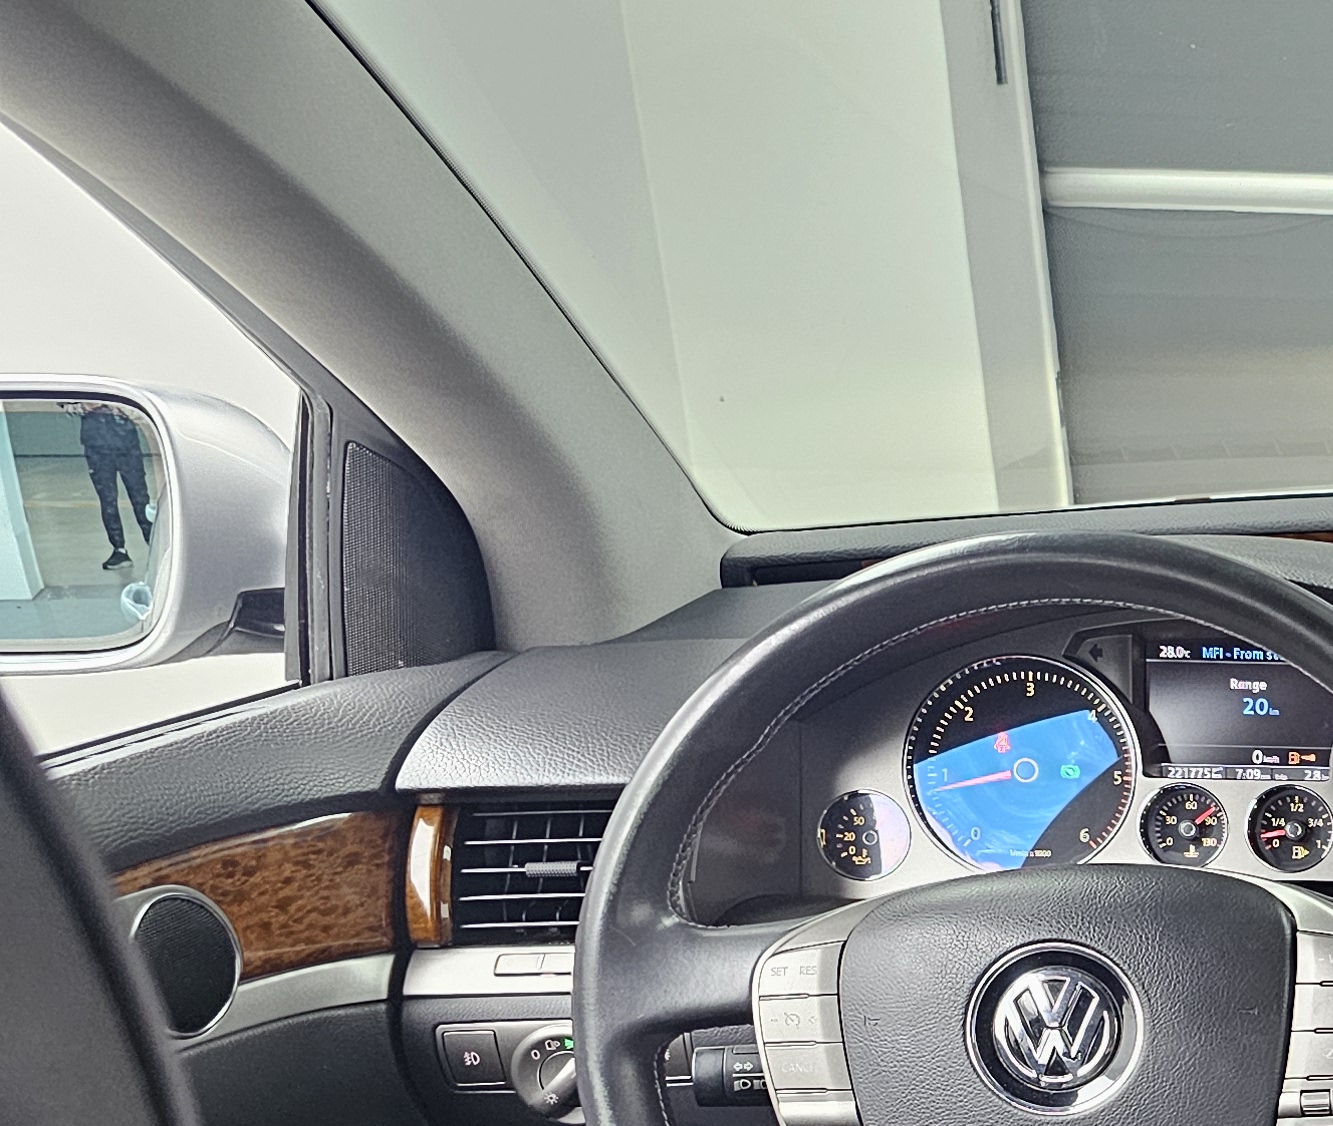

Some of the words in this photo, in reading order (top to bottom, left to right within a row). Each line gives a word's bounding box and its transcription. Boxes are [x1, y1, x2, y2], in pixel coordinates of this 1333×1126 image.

[1202, 647, 1223, 659] MFI
[1234, 648, 1263, 660] From
[1026, 683, 1035, 697] 3
[1230, 678, 1267, 693] Range
[1243, 698, 1268, 715] 20
[964, 706, 974, 722] 2
[1088, 710, 1098, 723] 4
[1252, 750, 1263, 764] 0
[942, 768, 948, 782] 1
[1113, 771, 1123, 785] 5
[1168, 767, 1212, 779] 221775
[1185, 801, 1197, 810] 60
[1290, 803, 1305, 812] 1/2
[853, 816, 865, 825] 50
[1165, 816, 1177, 825] 30
[1205, 816, 1217, 826] 90
[1271, 818, 1286, 827] 1/4
[1307, 818, 1324, 828] 3/4
[843, 832, 856, 841] 20
[970, 826, 981, 840] 0
[1079, 828, 1090, 843] 6
[1166, 836, 1174, 846] 0
[1201, 838, 1217, 847] 130
[1272, 839, 1280, 848] 0
[1315, 840, 1321, 849] 1
[848, 846, 856, 855] 0
[771, 966, 788, 976] SET
[799, 965, 817, 976] RES
[994, 966, 1118, 1088] VW
